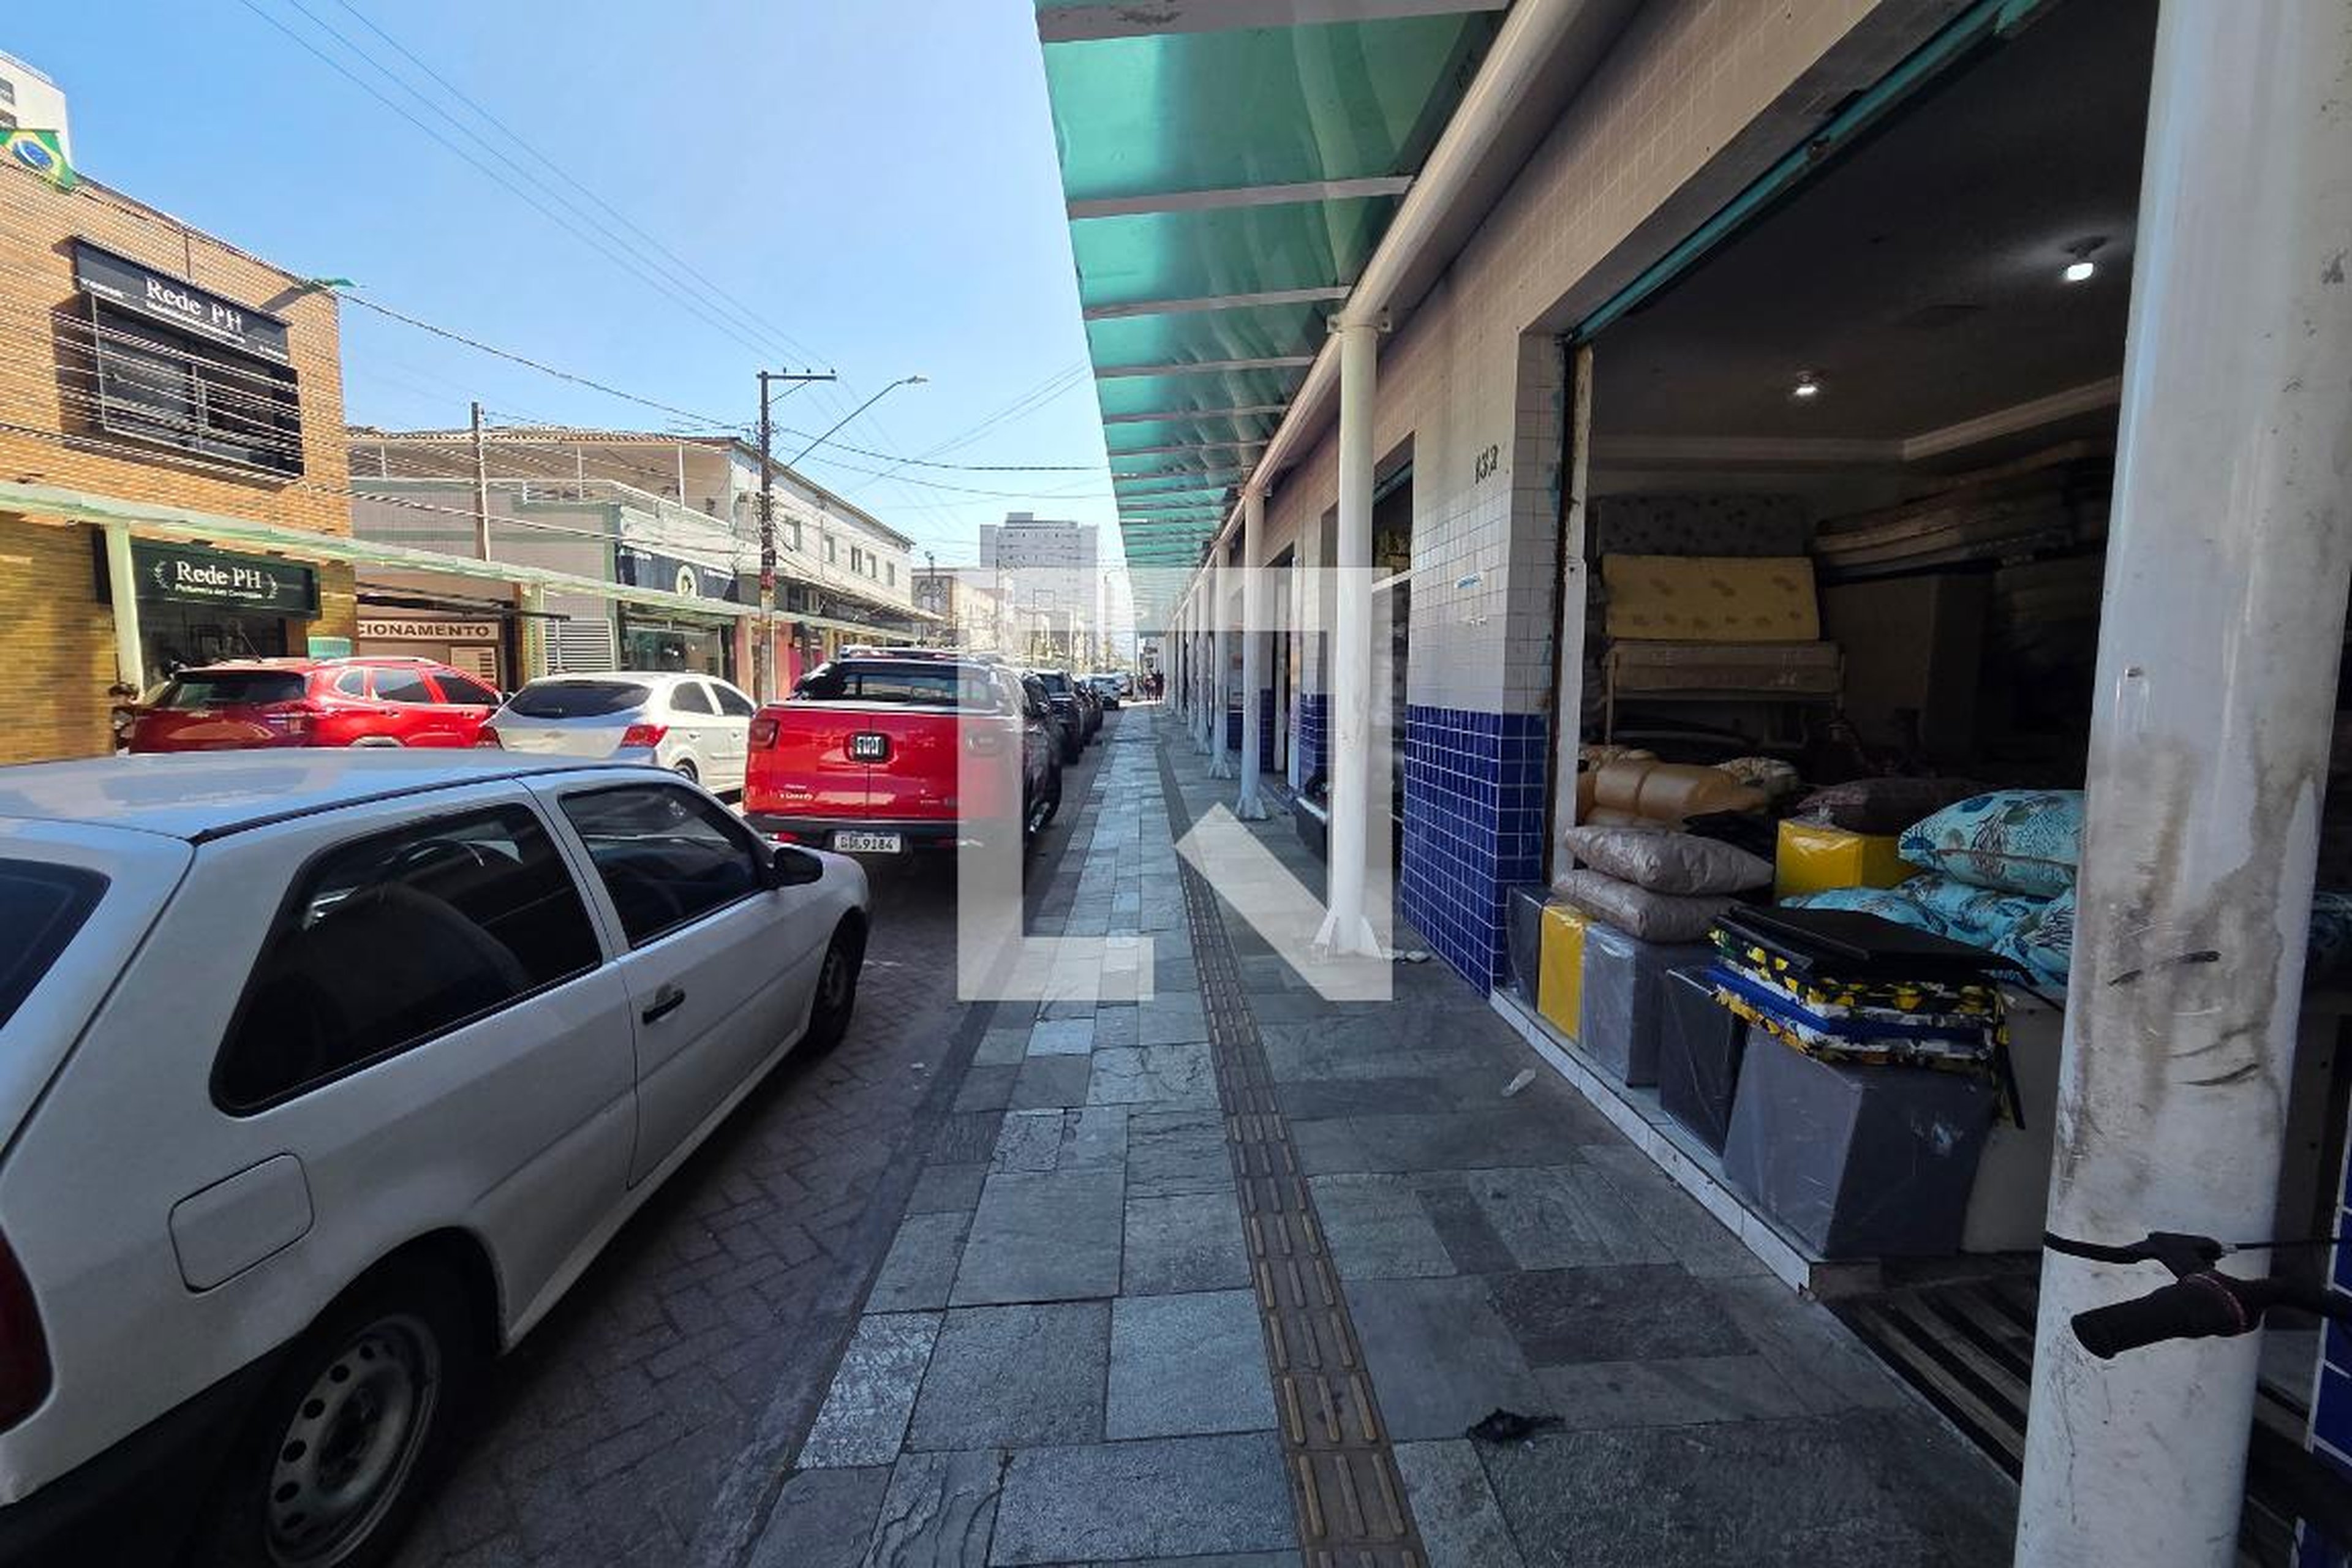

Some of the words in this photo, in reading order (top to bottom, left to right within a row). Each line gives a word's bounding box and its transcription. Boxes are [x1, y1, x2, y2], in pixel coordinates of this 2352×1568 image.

[145, 276, 201, 315] Rede
[210, 301, 243, 334] PH
[1475, 445, 1498, 484] 132
[175, 561, 227, 585] Rede
[232, 567, 262, 589] PH
[856, 736, 881, 755] FIAT
